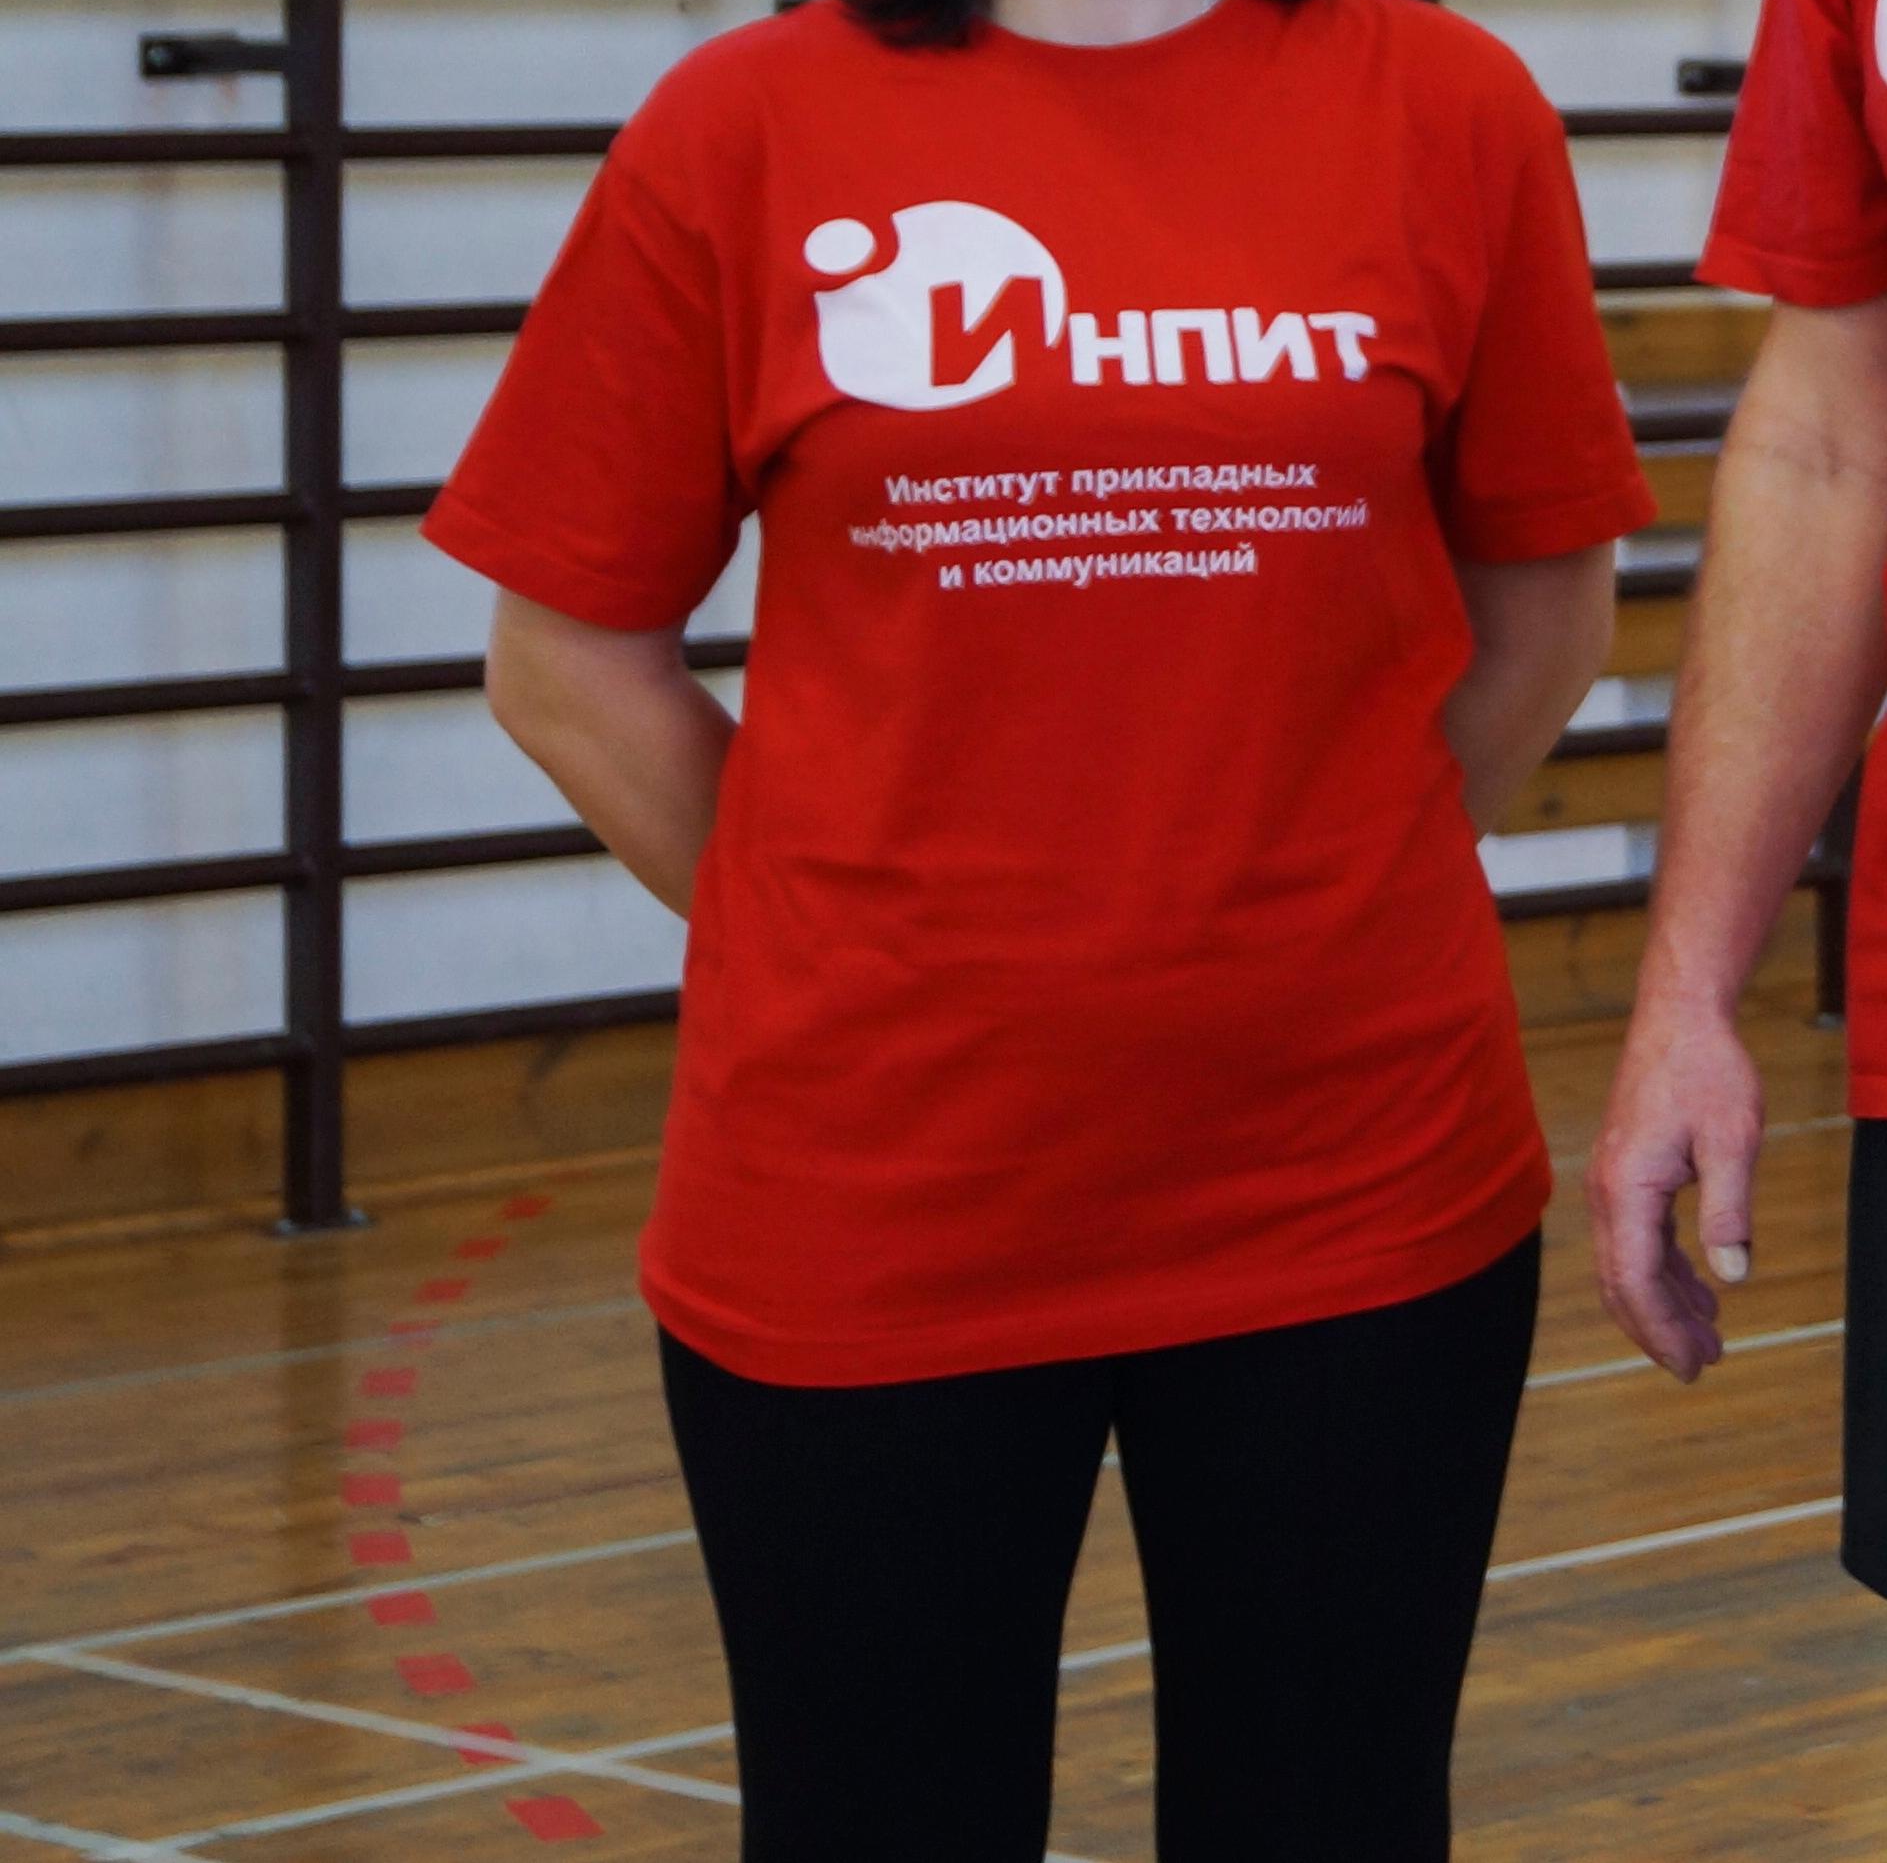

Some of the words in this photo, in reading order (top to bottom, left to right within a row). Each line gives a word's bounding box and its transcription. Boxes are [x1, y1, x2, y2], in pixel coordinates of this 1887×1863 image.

[884, 470, 1061, 505] Институт
[1071, 462, 1319, 500] прикладных
[848, 506, 1162, 554] информационных
[1170, 497, 1369, 532] технологий
[938, 563, 965, 590] и
[972, 541, 1257, 589] коммуникаций
